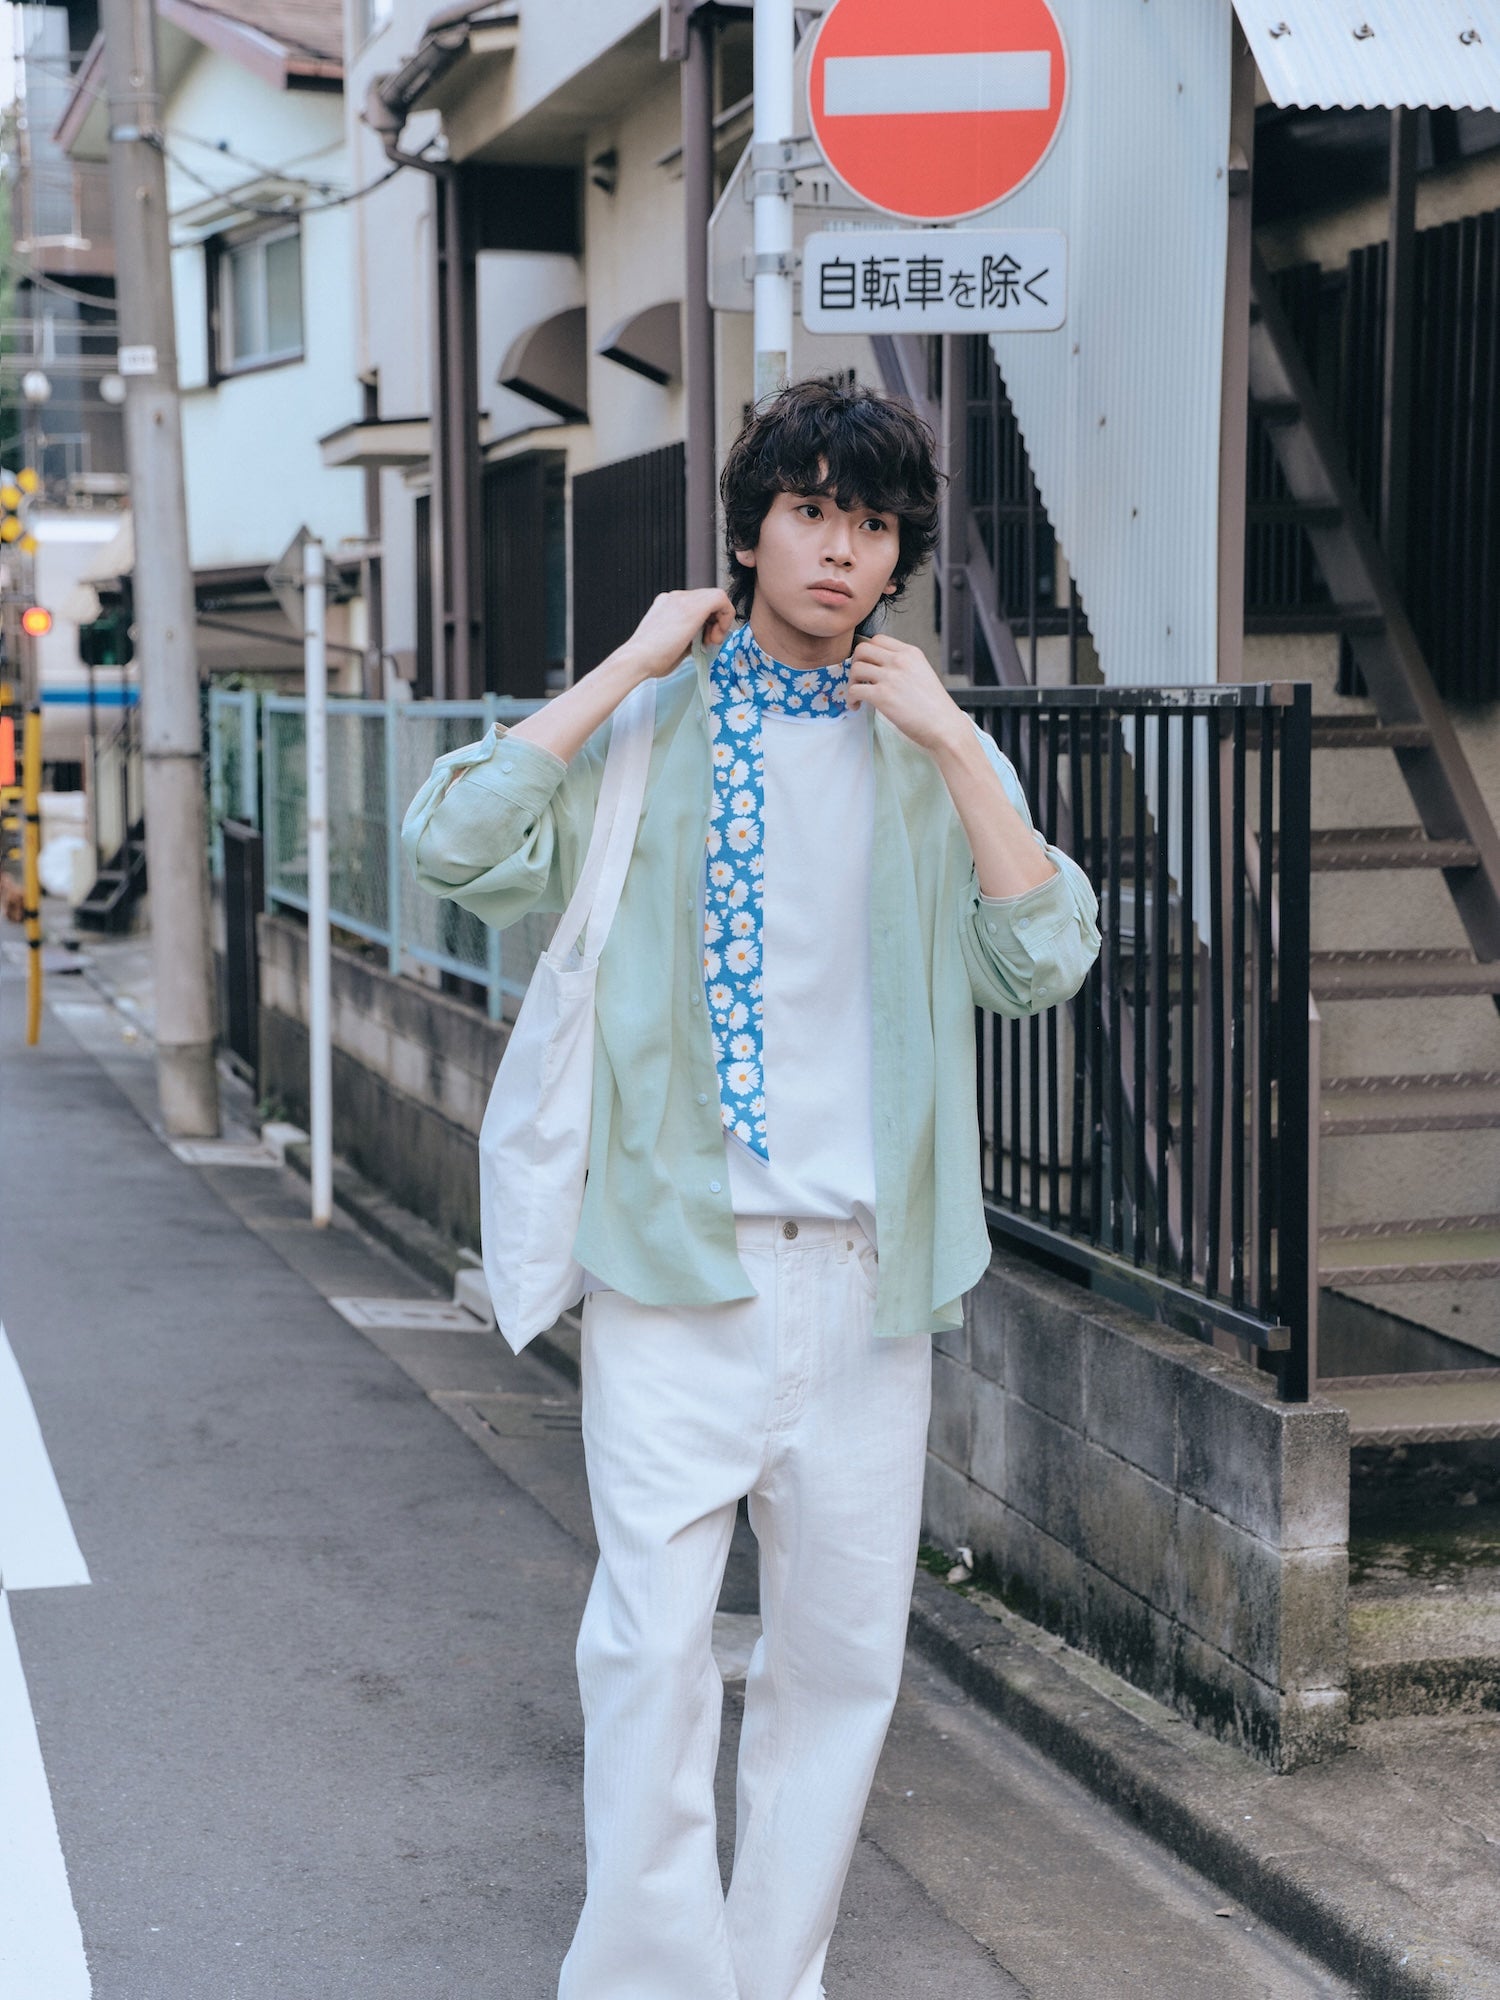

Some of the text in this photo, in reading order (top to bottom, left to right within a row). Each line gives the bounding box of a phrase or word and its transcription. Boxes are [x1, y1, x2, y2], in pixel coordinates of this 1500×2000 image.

[820, 254, 1049, 311] 自転車を除く
